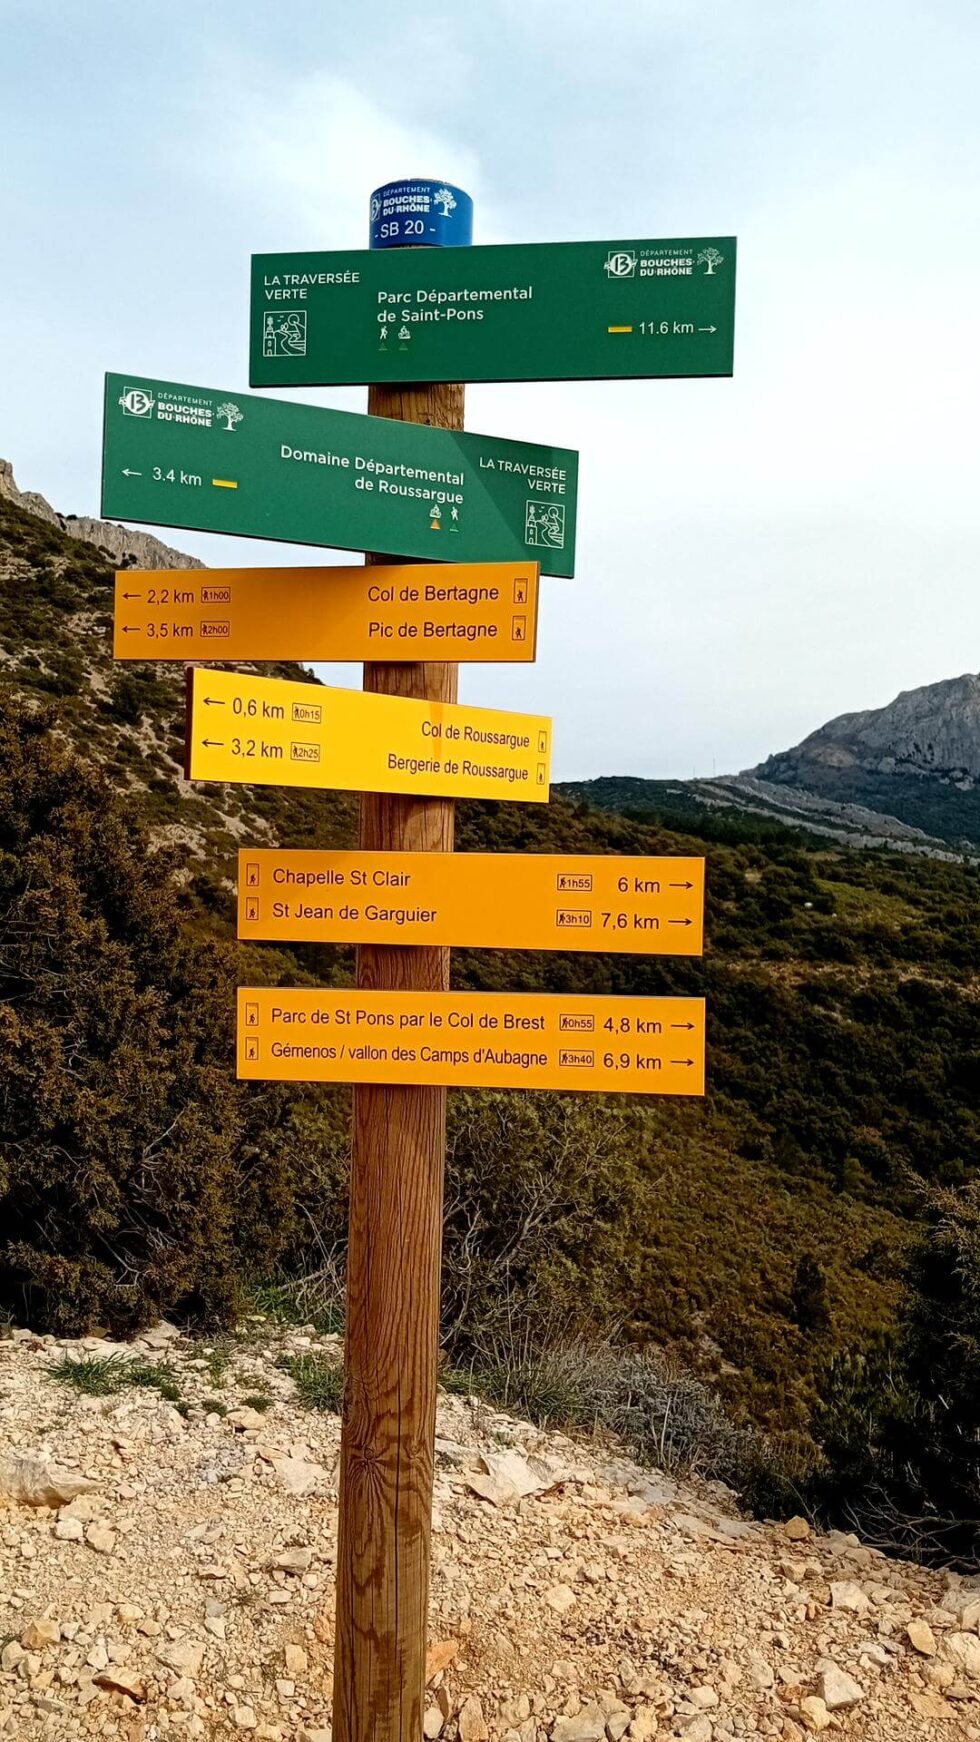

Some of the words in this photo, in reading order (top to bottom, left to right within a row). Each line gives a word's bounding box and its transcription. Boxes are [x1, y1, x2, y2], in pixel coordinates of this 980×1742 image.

[383, 187, 430, 197] DÉPARTEMENT
[380, 221, 399, 238] SB
[405, 220, 424, 234] 20
[640, 249, 693, 257] DÉPARTEMENT
[264, 275, 280, 286] LA
[284, 270, 360, 285] TRAVERSÉE
[265, 288, 307, 300] VERTE
[378, 291, 411, 303] Parc
[416, 286, 533, 304] Départemental
[377, 310, 396, 322] de
[401, 308, 484, 322] Saint-Pons
[639, 321, 669, 334] 11.6
[673, 321, 694, 334] km
[158, 391, 213, 406] DÉPARTEMENT
[280, 444, 350, 468] Domaine
[355, 457, 464, 486] Départemental
[480, 457, 495, 469] LA
[498, 460, 566, 480] TRAVERSÉE
[153, 467, 175, 483] 3.4
[181, 471, 202, 486] km
[355, 477, 373, 491] de
[379, 480, 463, 504] Roussargue
[528, 479, 565, 494] VERTE
[147, 589, 169, 605] 2,2
[174, 590, 194, 603] km
[209, 592, 229, 600] 1h00
[368, 586, 394, 601] Col
[400, 586, 419, 601] de
[425, 586, 499, 604] Bertagne
[147, 623, 168, 639] 3,5
[173, 624, 193, 637] km
[208, 626, 228, 634] 2h00
[369, 622, 393, 637] Pic
[398, 622, 417, 637] de
[424, 622, 497, 641] Bertagne
[233, 697, 257, 717] 0,6
[263, 701, 284, 719] km
[300, 709, 320, 720] 0h15
[422, 721, 441, 738] Col
[446, 725, 460, 739] de
[464, 726, 530, 749] Roussargue
[231, 738, 255, 758] 3,2
[261, 741, 283, 758] km
[299, 748, 319, 758] 2h25
[388, 753, 440, 774] Bergerie
[444, 760, 458, 774] de
[462, 760, 528, 782] Roussargue
[273, 868, 344, 887] Chapelle
[350, 870, 367, 885] St
[372, 871, 410, 886] Clair
[567, 879, 590, 888] 1h55
[618, 877, 628, 892] 6
[635, 878, 660, 893] km
[272, 903, 289, 918] St
[295, 904, 333, 919] Jean
[339, 905, 359, 920] de
[365, 905, 437, 925] Garguier
[566, 915, 589, 924] 3h10
[601, 913, 628, 930] 7,6
[634, 914, 659, 929] km
[272, 1008, 306, 1024] Parc
[311, 1009, 330, 1024] de
[335, 1010, 350, 1025] St
[356, 1010, 394, 1026] Pons
[400, 1015, 424, 1029] par
[430, 1012, 442, 1026] le
[448, 1012, 473, 1027] Col
[479, 1014, 498, 1028] de
[503, 1014, 545, 1030] Brest
[569, 1019, 592, 1028] 0h55
[604, 1017, 630, 1035] 4,8
[637, 1018, 662, 1033] km
[271, 1042, 336, 1059] Gémenos
[349, 1045, 387, 1060] vallon
[392, 1046, 416, 1061] des
[420, 1046, 469, 1066] Camps
[473, 1048, 548, 1068] d'Aubagne
[568, 1055, 592, 1064] 3h40
[604, 1053, 630, 1070] 6,9
[637, 1054, 662, 1069] km
